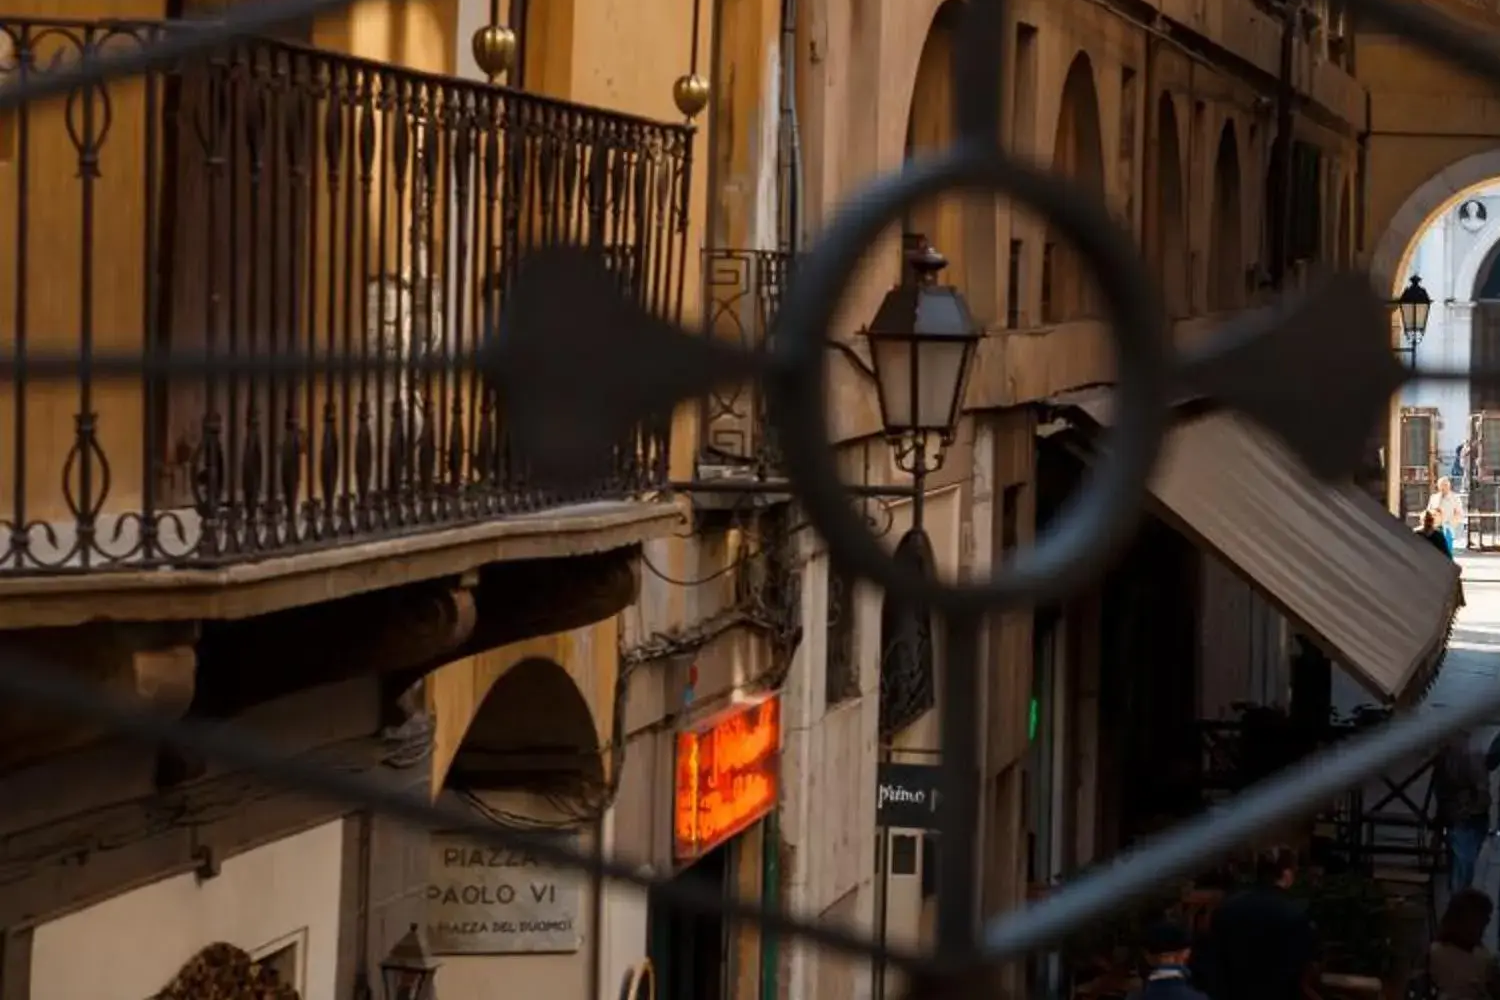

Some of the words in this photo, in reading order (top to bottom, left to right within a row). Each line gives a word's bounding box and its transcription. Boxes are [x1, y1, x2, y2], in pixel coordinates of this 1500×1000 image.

[444, 848, 538, 867] PIAZZA
[425, 883, 516, 905] PAOLO
[530, 883, 557, 905] VI
